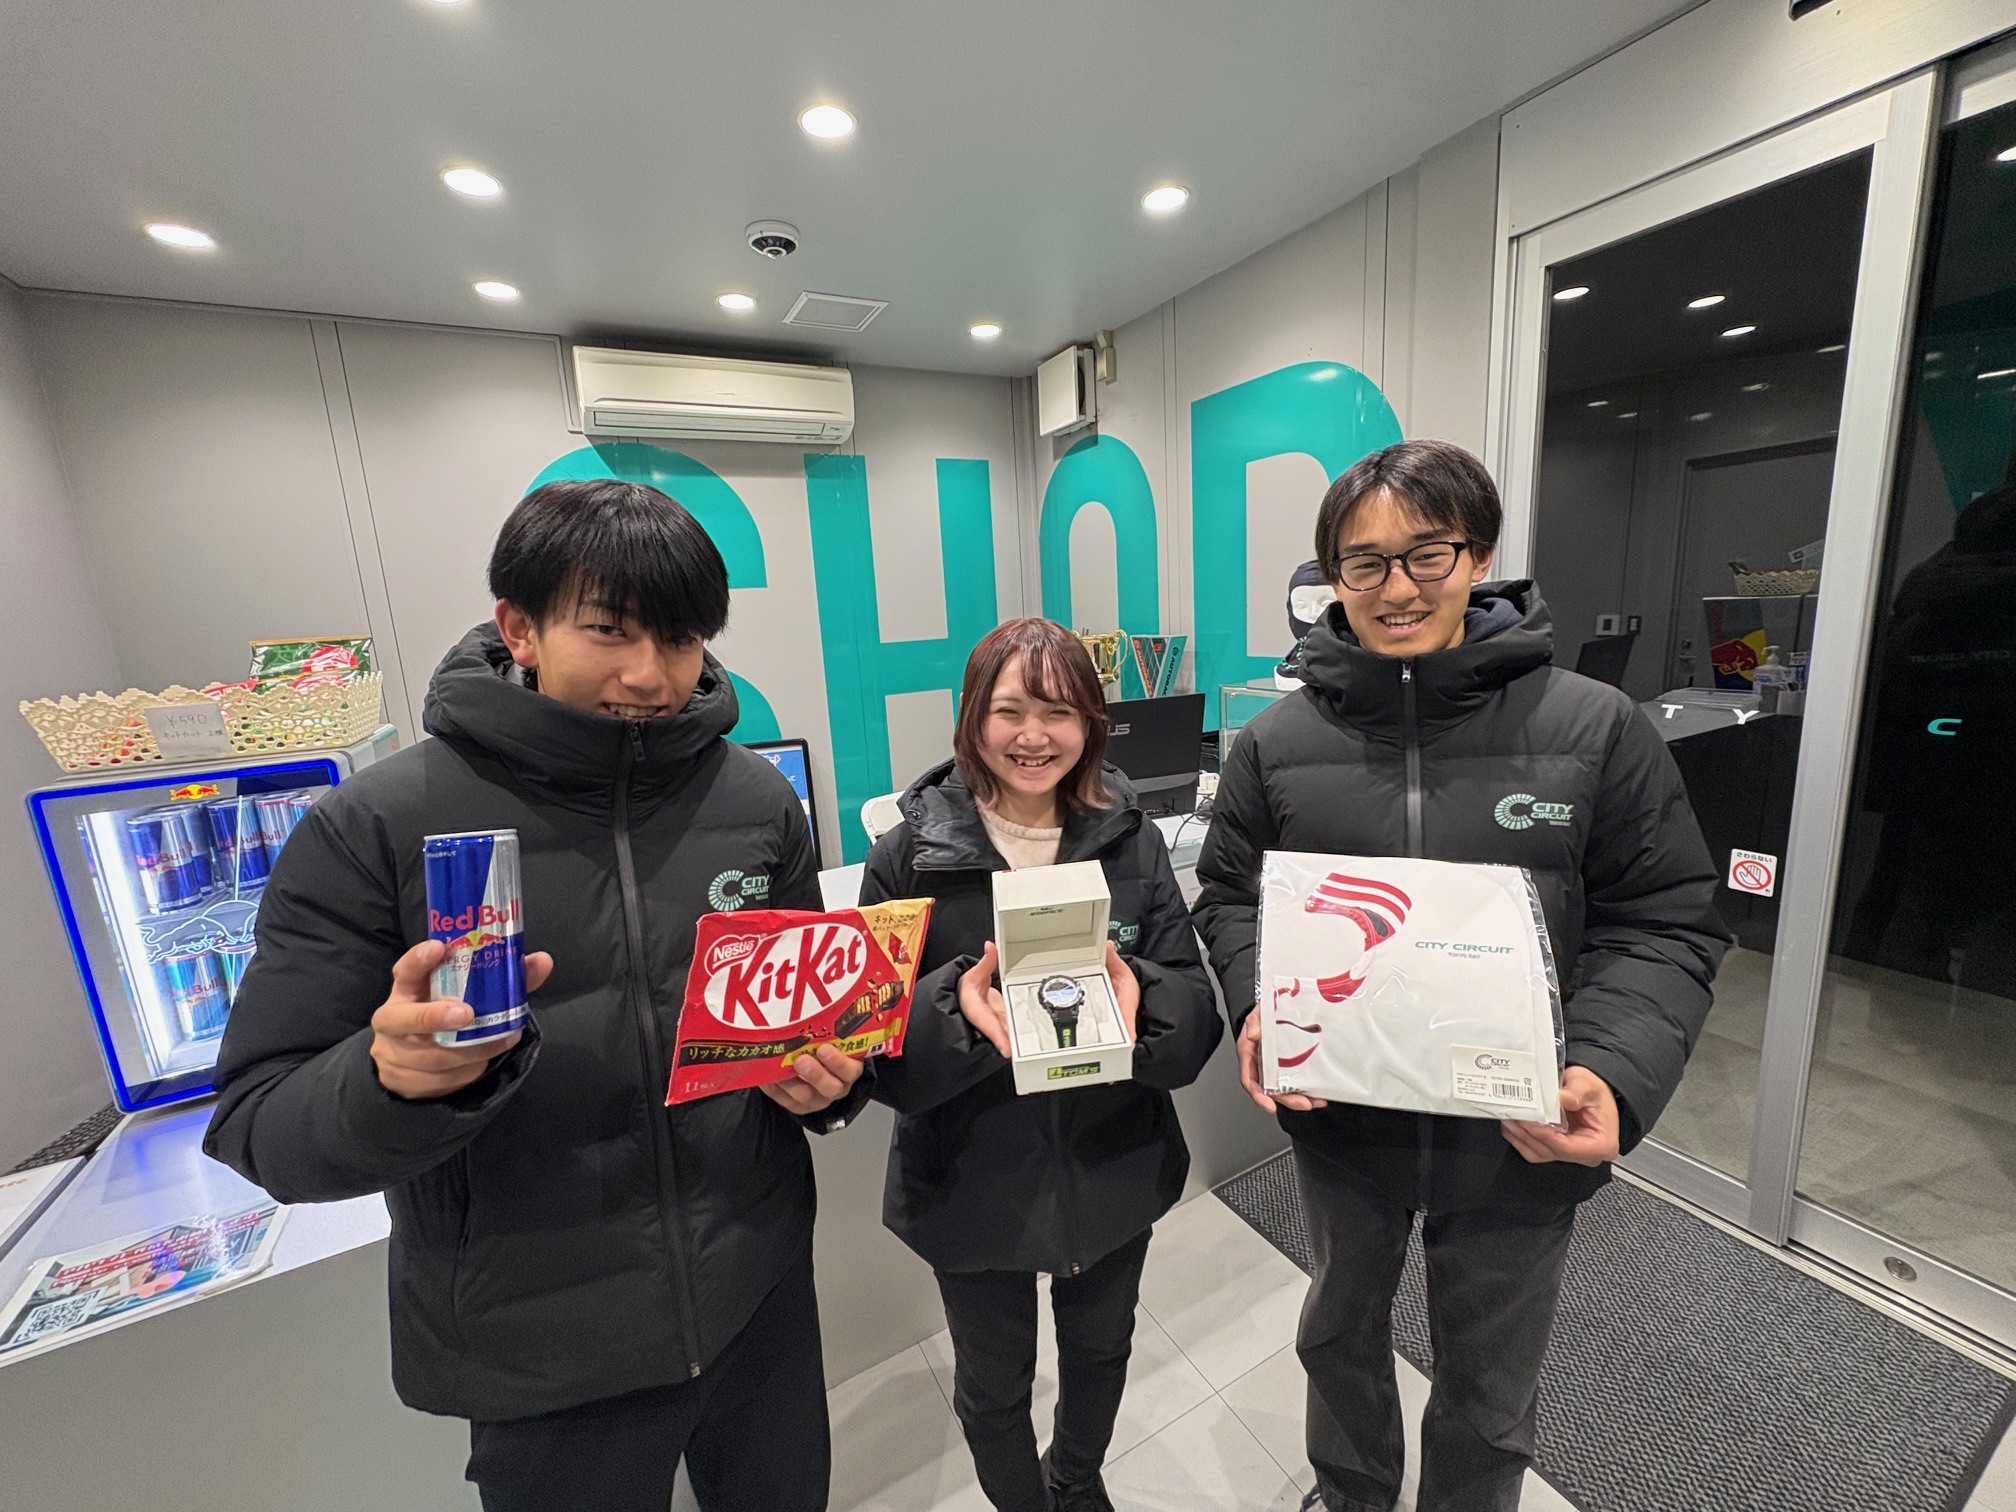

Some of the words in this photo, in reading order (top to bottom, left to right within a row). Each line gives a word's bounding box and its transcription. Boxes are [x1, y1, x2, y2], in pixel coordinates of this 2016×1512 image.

[1107, 722, 1131, 736] US
[1531, 802, 1574, 814] CITY
[1530, 812, 1573, 821] CIRCUIT
[1736, 851, 1773, 863] さわらない
[741, 874, 770, 889] CITY
[741, 886, 770, 896] CIRCUIT
[430, 906, 474, 932] Red
[478, 898, 520, 927] Bull
[1414, 941, 1449, 950] CITY
[1452, 943, 1515, 954] CIRCUIT
[722, 925, 863, 1027] KitKat
[689, 1043, 786, 1060] リッチなカカオ感
[1490, 1057, 1512, 1065] CITY
